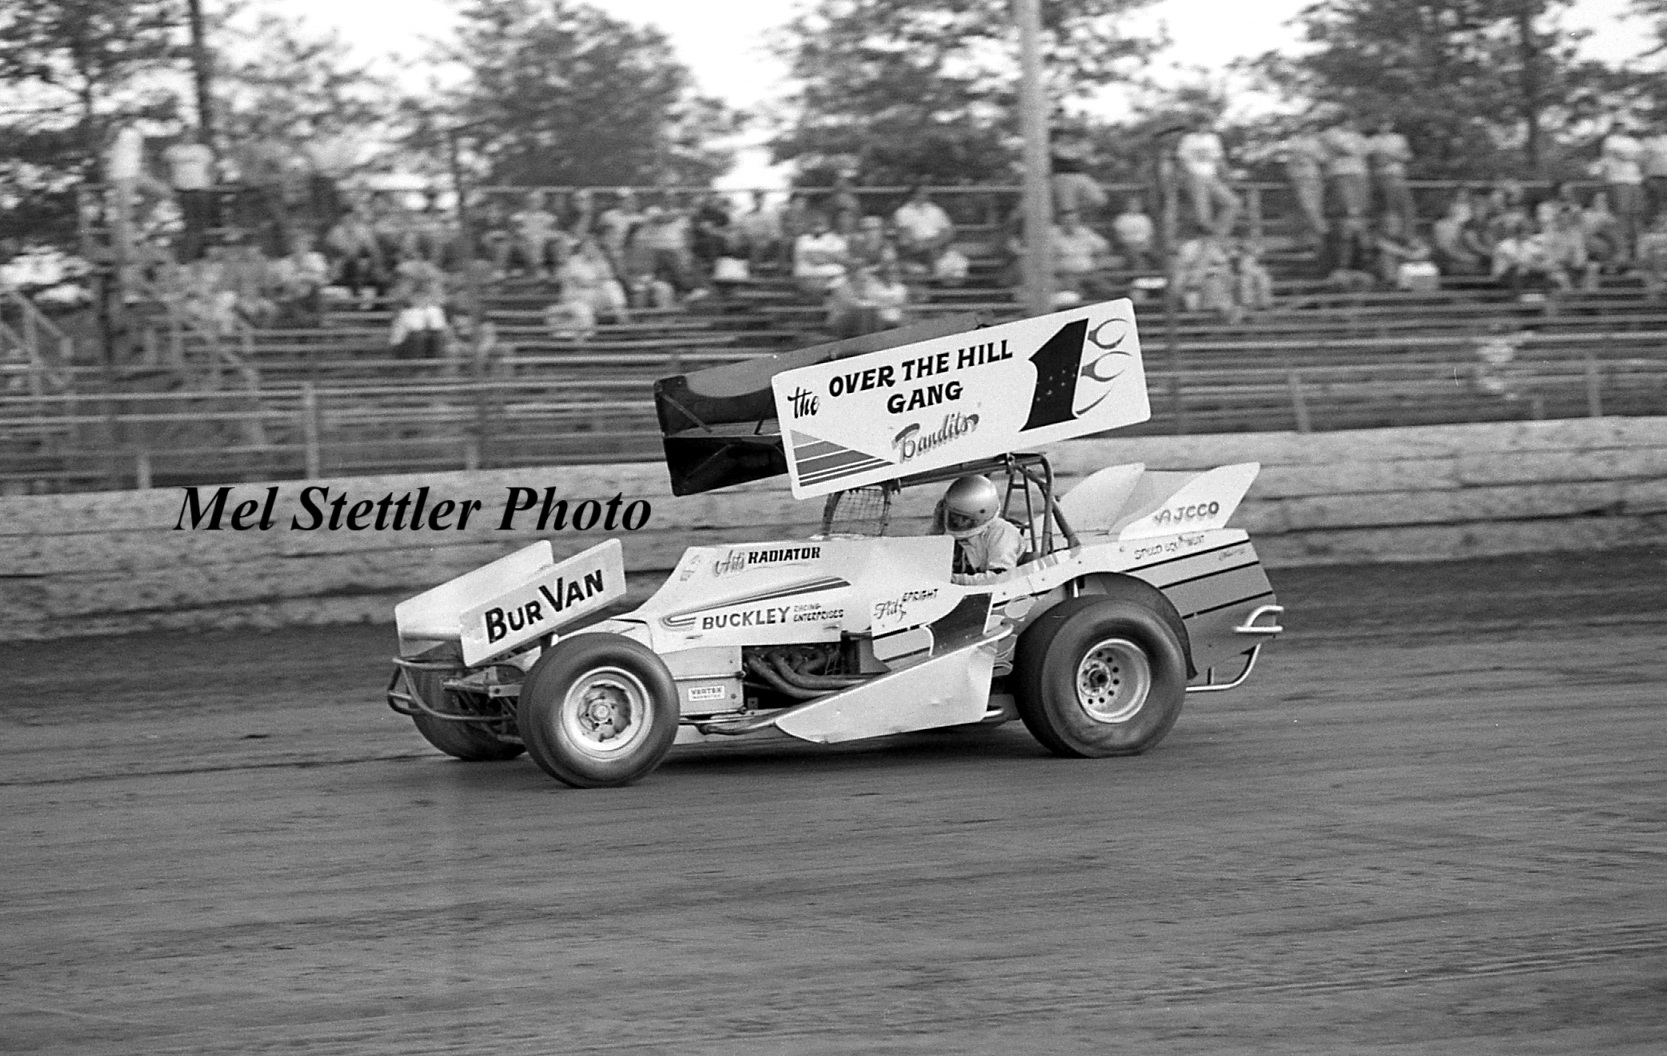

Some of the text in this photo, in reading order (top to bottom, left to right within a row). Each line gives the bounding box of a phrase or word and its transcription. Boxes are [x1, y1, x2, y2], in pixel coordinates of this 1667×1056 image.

[828, 339, 1014, 397] OVER THE HILL
[1019, 318, 1089, 433] 1
[788, 386, 820, 418] the
[886, 381, 963, 414] GANG
[890, 412, 980, 463] Bandits
[748, 547, 821, 564] RADIATOR
[702, 606, 791, 630] BUCKLEY
[793, 609, 844, 622] ENTERPRISES
